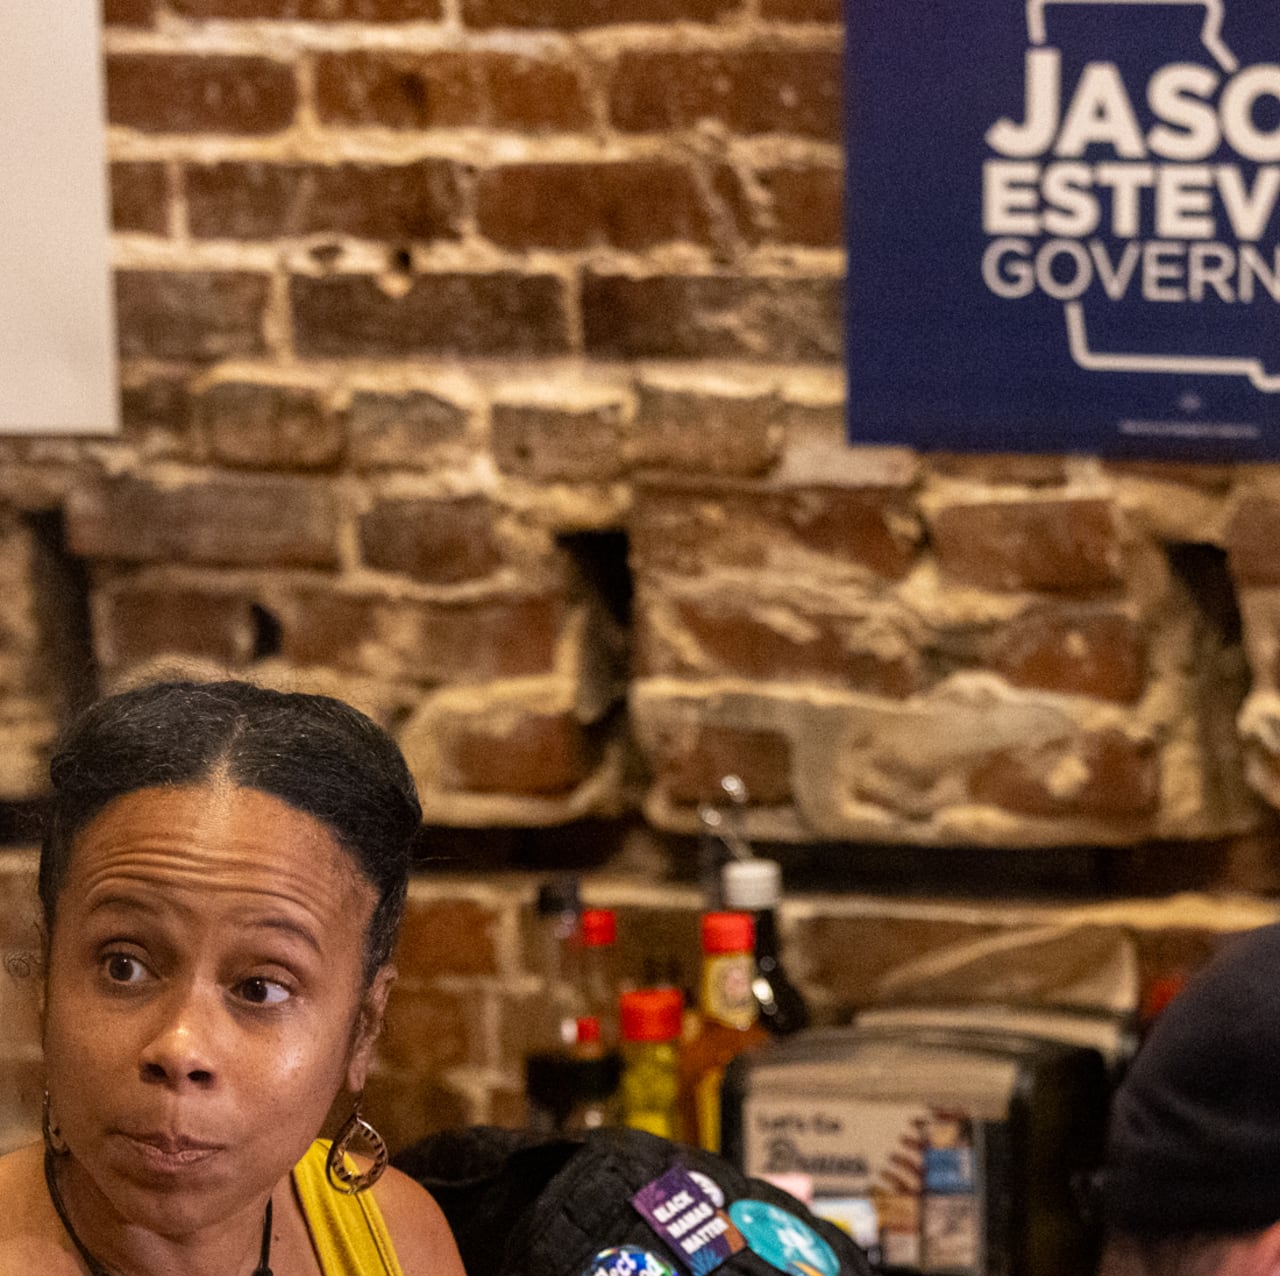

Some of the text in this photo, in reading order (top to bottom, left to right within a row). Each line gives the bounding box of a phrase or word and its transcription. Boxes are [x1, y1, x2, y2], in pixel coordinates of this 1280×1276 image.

[652, 1190, 696, 1224] BLACK
[666, 1201, 714, 1239] MAMAS
[680, 1216, 730, 1255] MATTER
